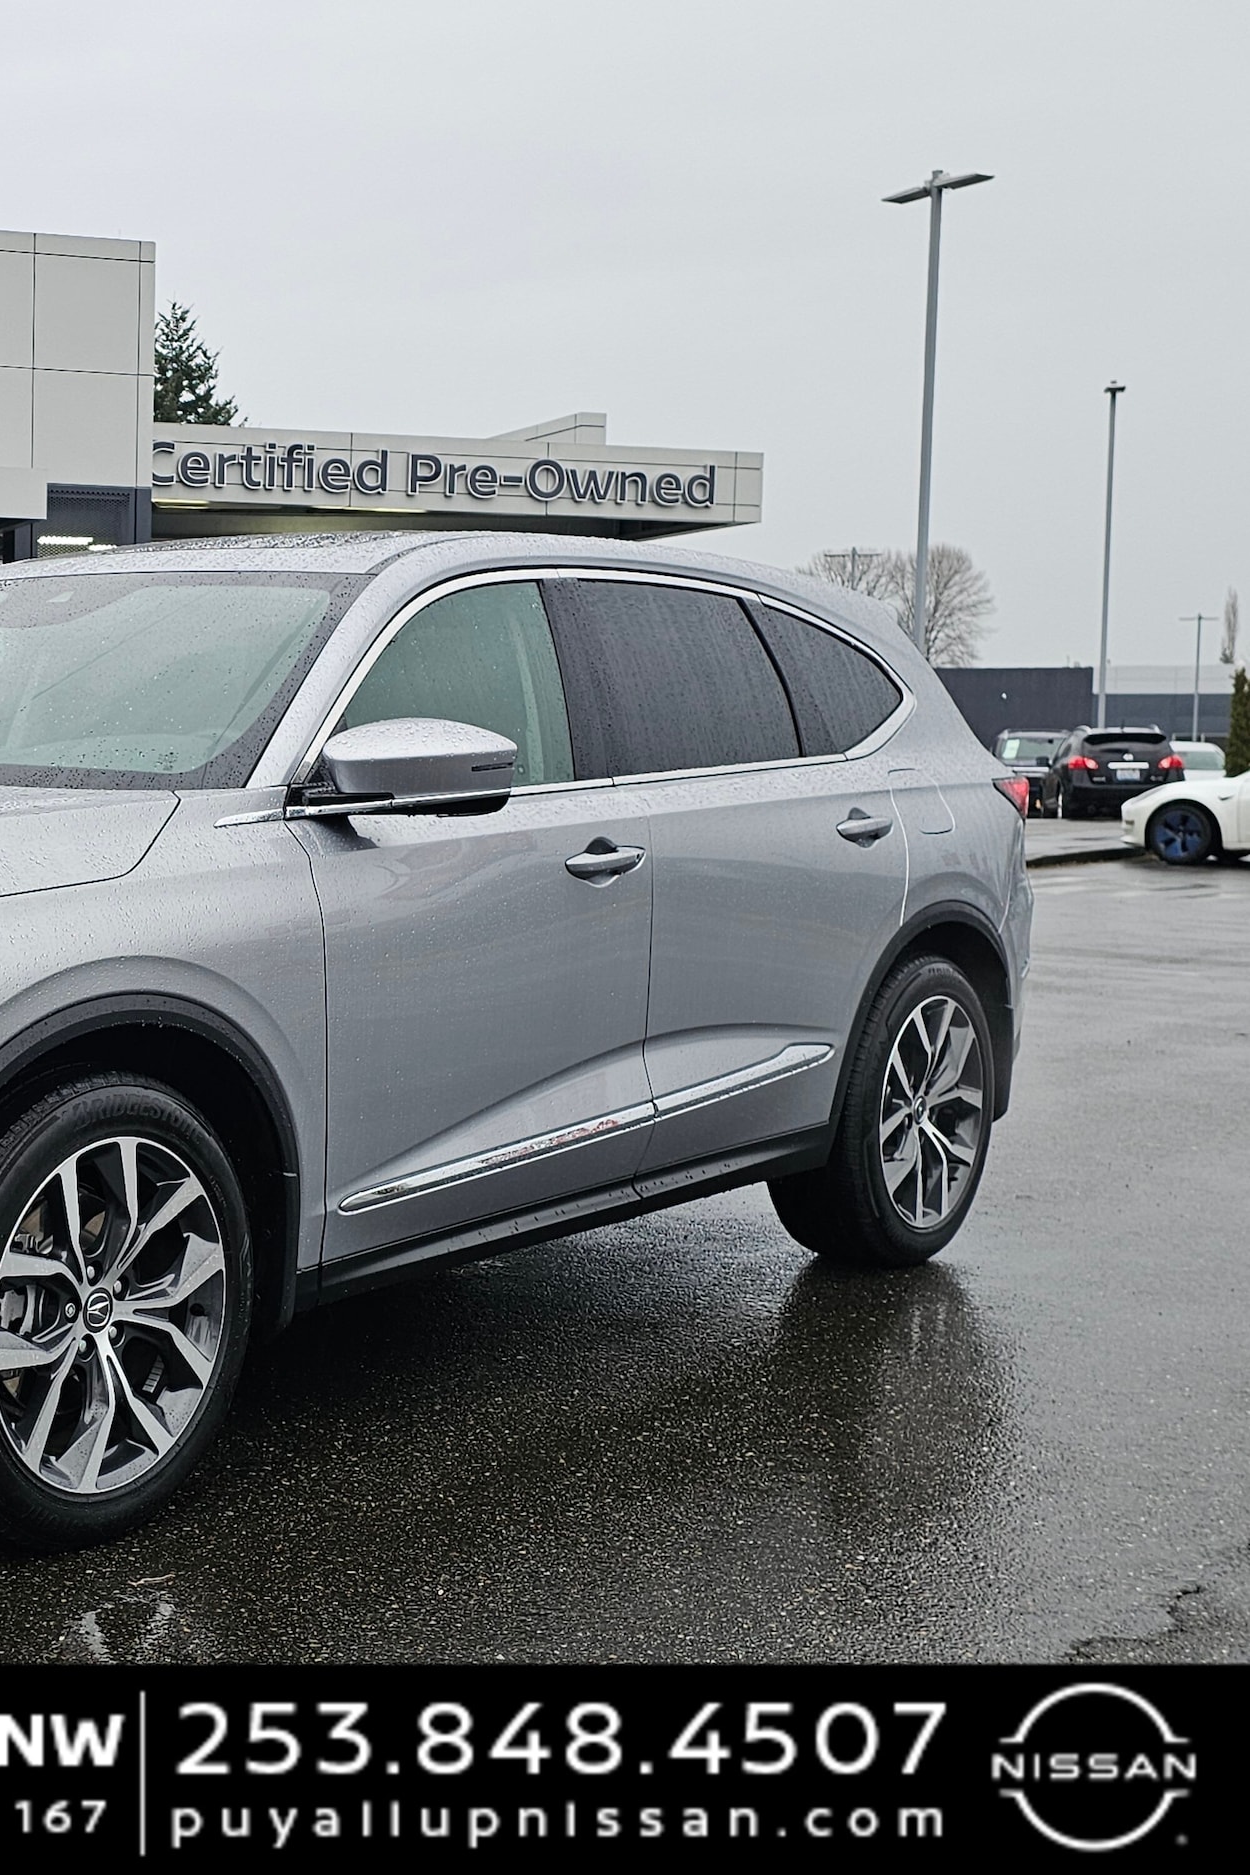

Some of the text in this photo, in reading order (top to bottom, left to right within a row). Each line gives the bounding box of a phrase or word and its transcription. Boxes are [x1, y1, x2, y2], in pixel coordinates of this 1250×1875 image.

[152, 440, 718, 508] Certified Pre-Owned
[72, 1092, 203, 1145] BRIDGESTONE
